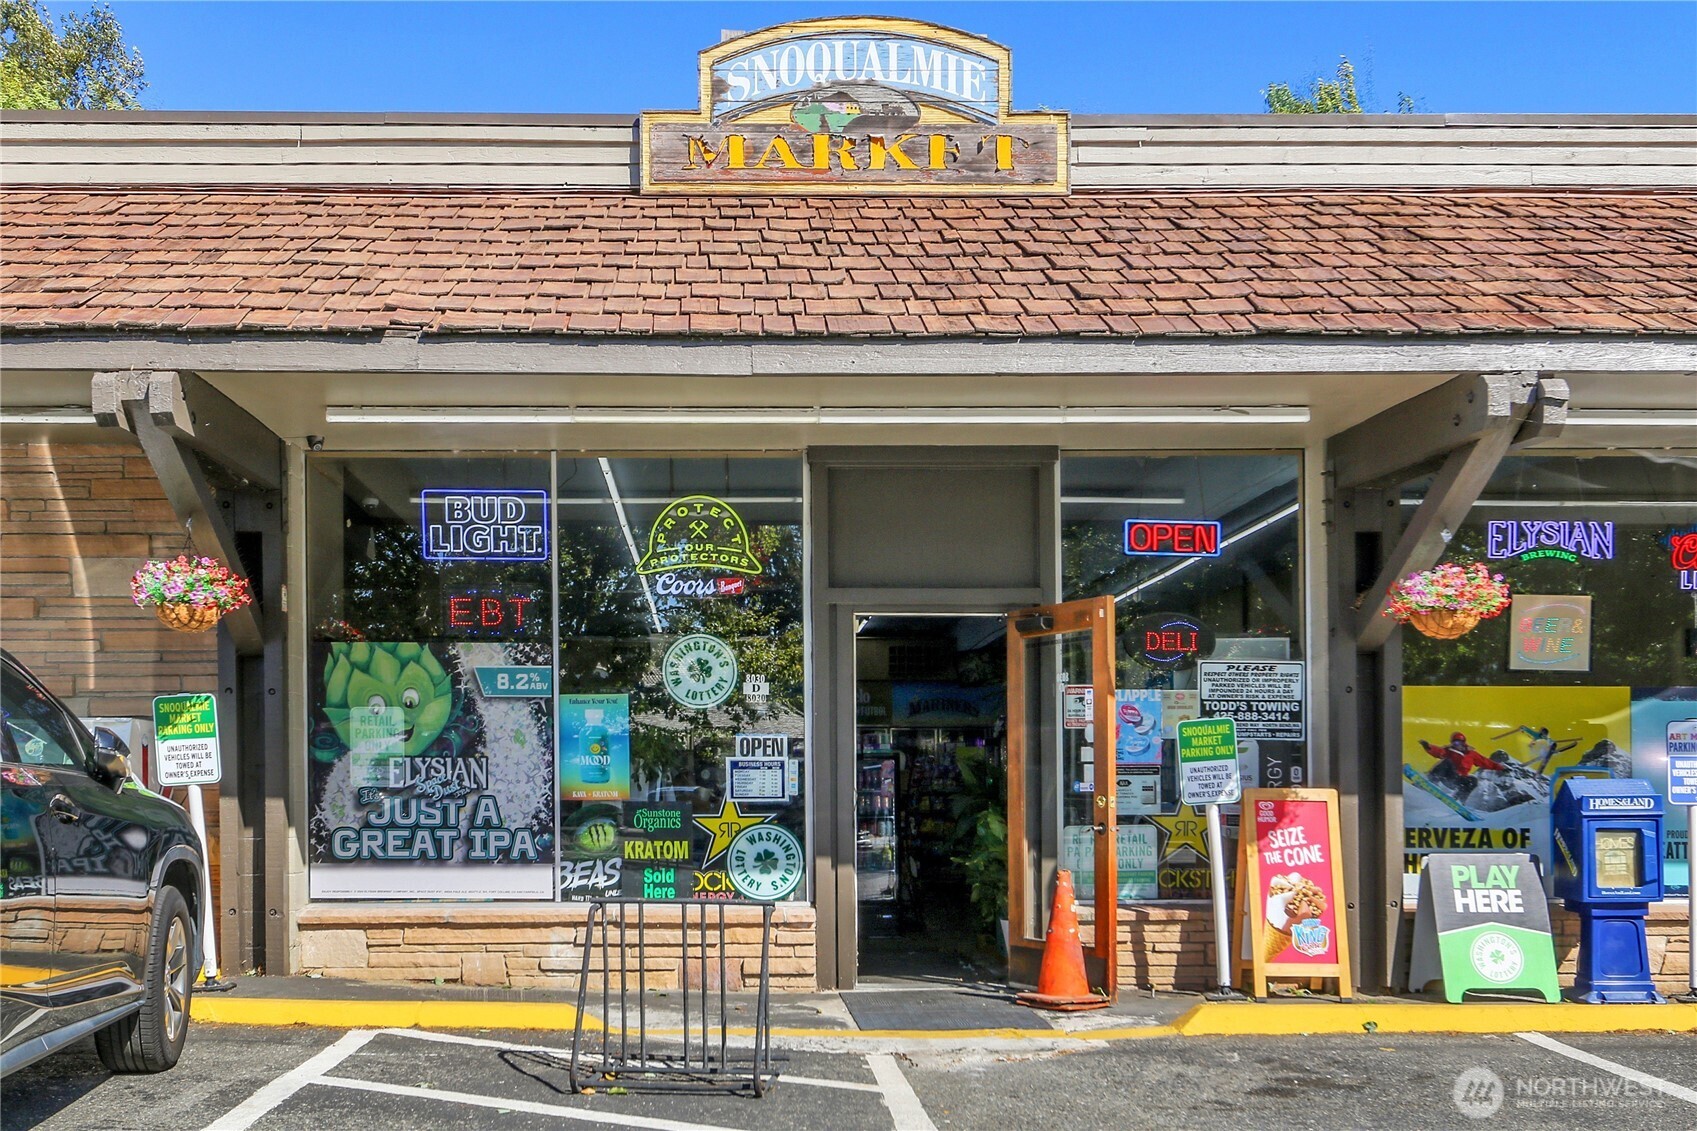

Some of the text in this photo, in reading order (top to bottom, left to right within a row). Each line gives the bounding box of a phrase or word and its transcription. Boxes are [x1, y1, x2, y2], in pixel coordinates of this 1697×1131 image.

[726, 39, 987, 108] SNOQUALMIE
[682, 133, 1029, 174] MARKET
[445, 496, 525, 524] BUD
[657, 504, 742, 544] PROTECT
[429, 524, 542, 553] LIGHT
[1129, 523, 1216, 552] OPEN
[1487, 520, 1614, 560] ELYSIAN
[685, 543, 714, 552] OUR
[1519, 549, 1578, 563] BREWING
[650, 552, 749, 567] PROTECTORS
[655, 573, 717, 595] Coors
[450, 598, 532, 626] EBT
[1519, 617, 1573, 633] BEER
[1146, 631, 1198, 651] DELI
[1522, 637, 1574, 653] WINE
[669, 640, 731, 687] WASHINGTON'S
[1226, 664, 1278, 672] PLEASE
[497, 673, 541, 690] 8.2%
[530, 682, 549, 690] ABV
[745, 674, 766, 683] 8030
[684, 675, 730, 701] LOTTERY
[752, 684, 761, 692] D
[158, 700, 211, 713] SNOQUALMIE
[1203, 701, 1248, 711] TODD'S
[1250, 701, 1300, 711] TOWING
[169, 712, 202, 724] MARKET
[360, 715, 396, 727] RETAIL
[1213, 711, 1290, 720] 425-888-3414
[158, 722, 215, 736] PARKING ONLY
[1182, 724, 1231, 737] SNOQUALMIE
[167, 743, 209, 753] UNAUTHORIZED
[739, 737, 783, 757] OPEN
[1191, 735, 1222, 747] MARKET
[164, 753, 190, 761] VEHICLES
[1181, 744, 1234, 758] PARKING ONLY
[580, 755, 611, 766] MOOD
[1189, 764, 1229, 774] UNAUTHORIZED
[190, 769, 215, 777] EXPENSE
[388, 757, 488, 789] ELYSIAN
[1187, 773, 1211, 782] VEHICLES
[1212, 773, 1224, 781] WILL
[1225, 772, 1232, 780] BE
[415, 773, 448, 794] Space
[430, 780, 462, 801] Dust
[1198, 782, 1216, 790] TOWED
[368, 797, 501, 825] JUST A
[1589, 797, 1655, 810] HOMES&LAND
[641, 808, 681, 818] Sunstone
[633, 814, 681, 832] Organics
[334, 829, 538, 858] GREAT IPA
[1268, 826, 1307, 849] SEIZE
[1404, 827, 1531, 849] ERVEZA OF
[624, 840, 689, 859] KRATOM
[1264, 844, 1324, 867] THE CONE
[745, 831, 797, 891] WASHINGTON'S
[1118, 858, 1144, 869] ONLY
[643, 867, 675, 884] Sold
[734, 848, 762, 892] LOTTERY
[1450, 865, 1520, 889] PLAY
[643, 883, 676, 899] Here
[1454, 888, 1524, 913] HERE
[1294, 924, 1329, 945] KING
